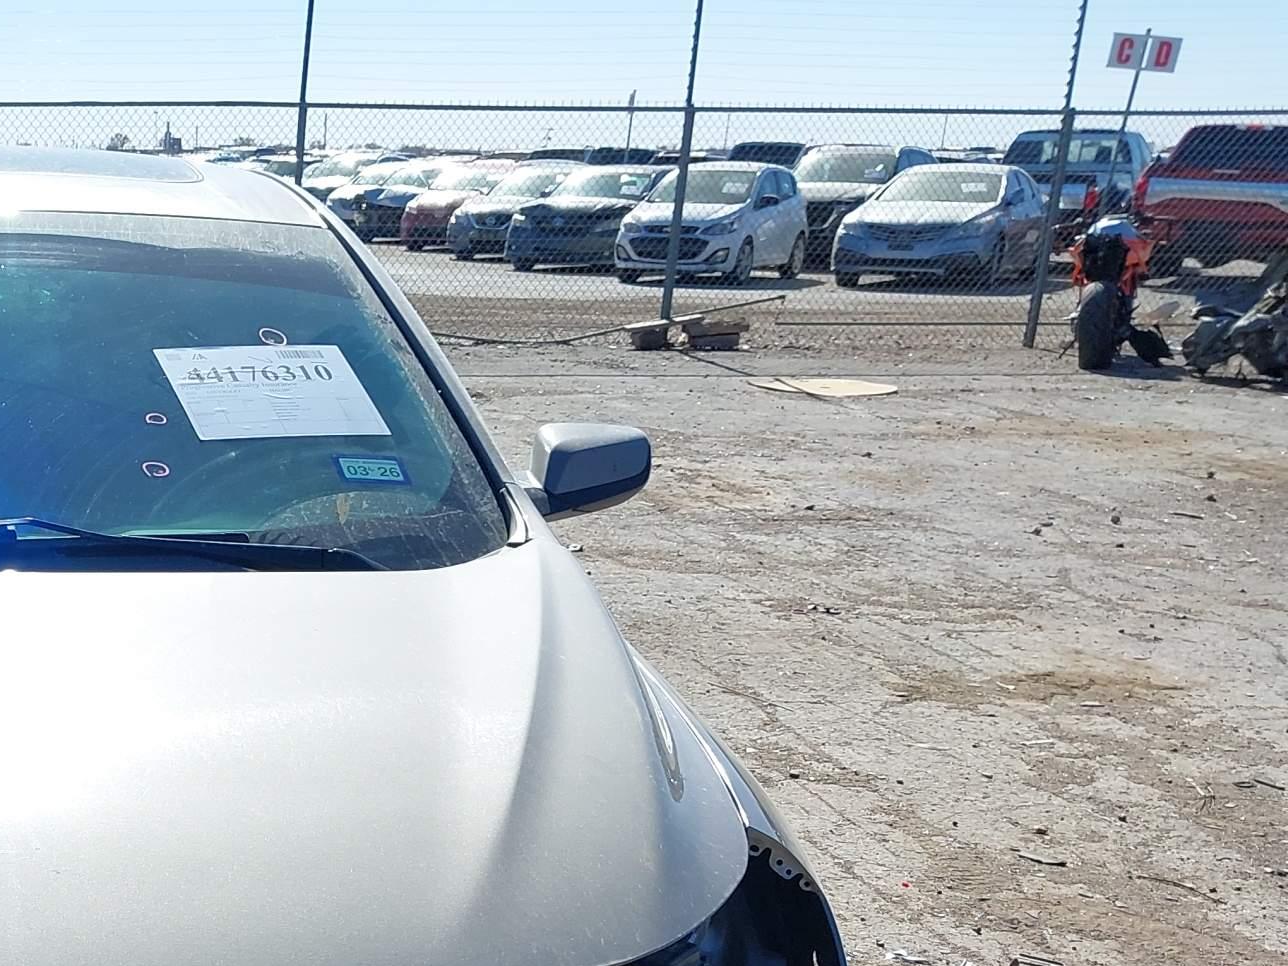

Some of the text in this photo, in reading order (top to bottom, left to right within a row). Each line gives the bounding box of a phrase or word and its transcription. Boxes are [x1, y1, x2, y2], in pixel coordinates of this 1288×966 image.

[1116, 37, 1172, 68] C D
[186, 364, 333, 382] 44176310
